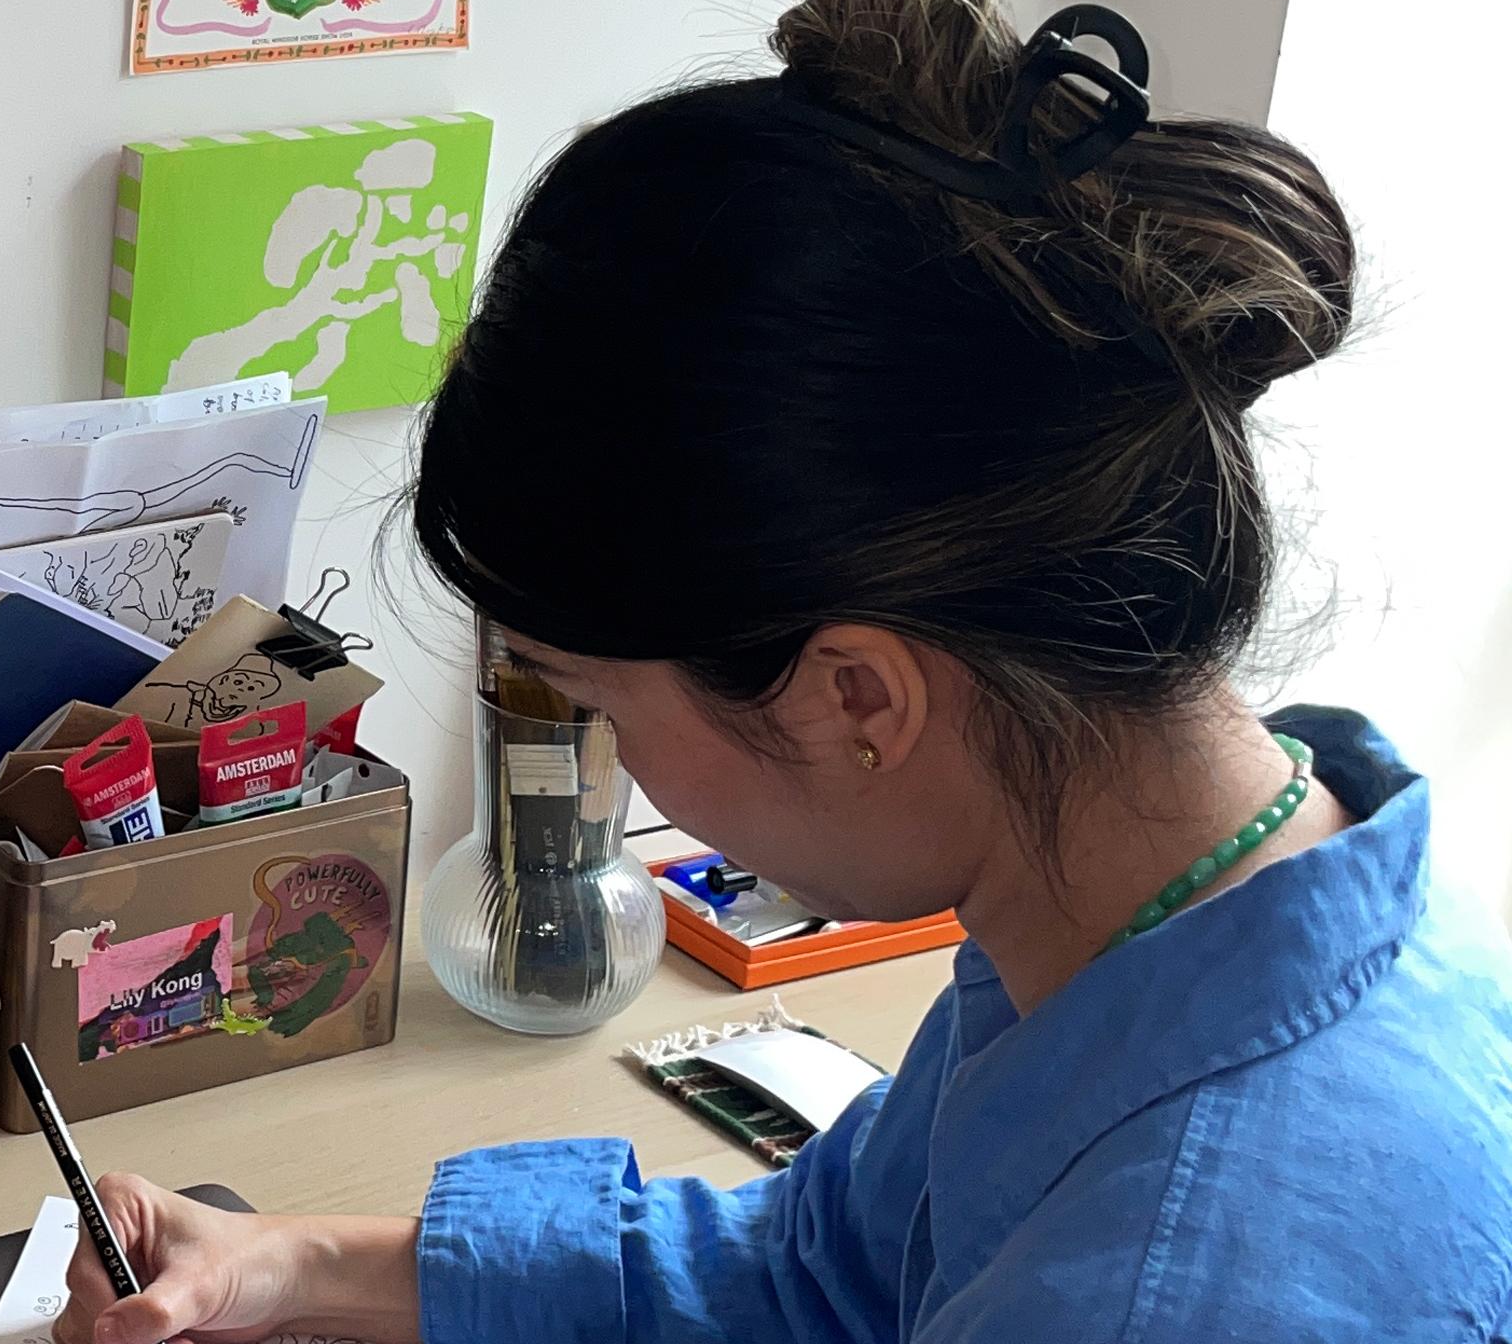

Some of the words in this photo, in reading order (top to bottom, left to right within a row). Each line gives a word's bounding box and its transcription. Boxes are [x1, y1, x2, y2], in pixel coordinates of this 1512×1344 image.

[217, 747, 297, 784] AMSTERDAM
[93, 768, 151, 804] AMSTERDAM
[285, 864, 380, 900] POWERFULLY
[291, 884, 347, 909] CUTE
[151, 970, 203, 999] Kong
[71, 1176, 106, 1239] MARKER
